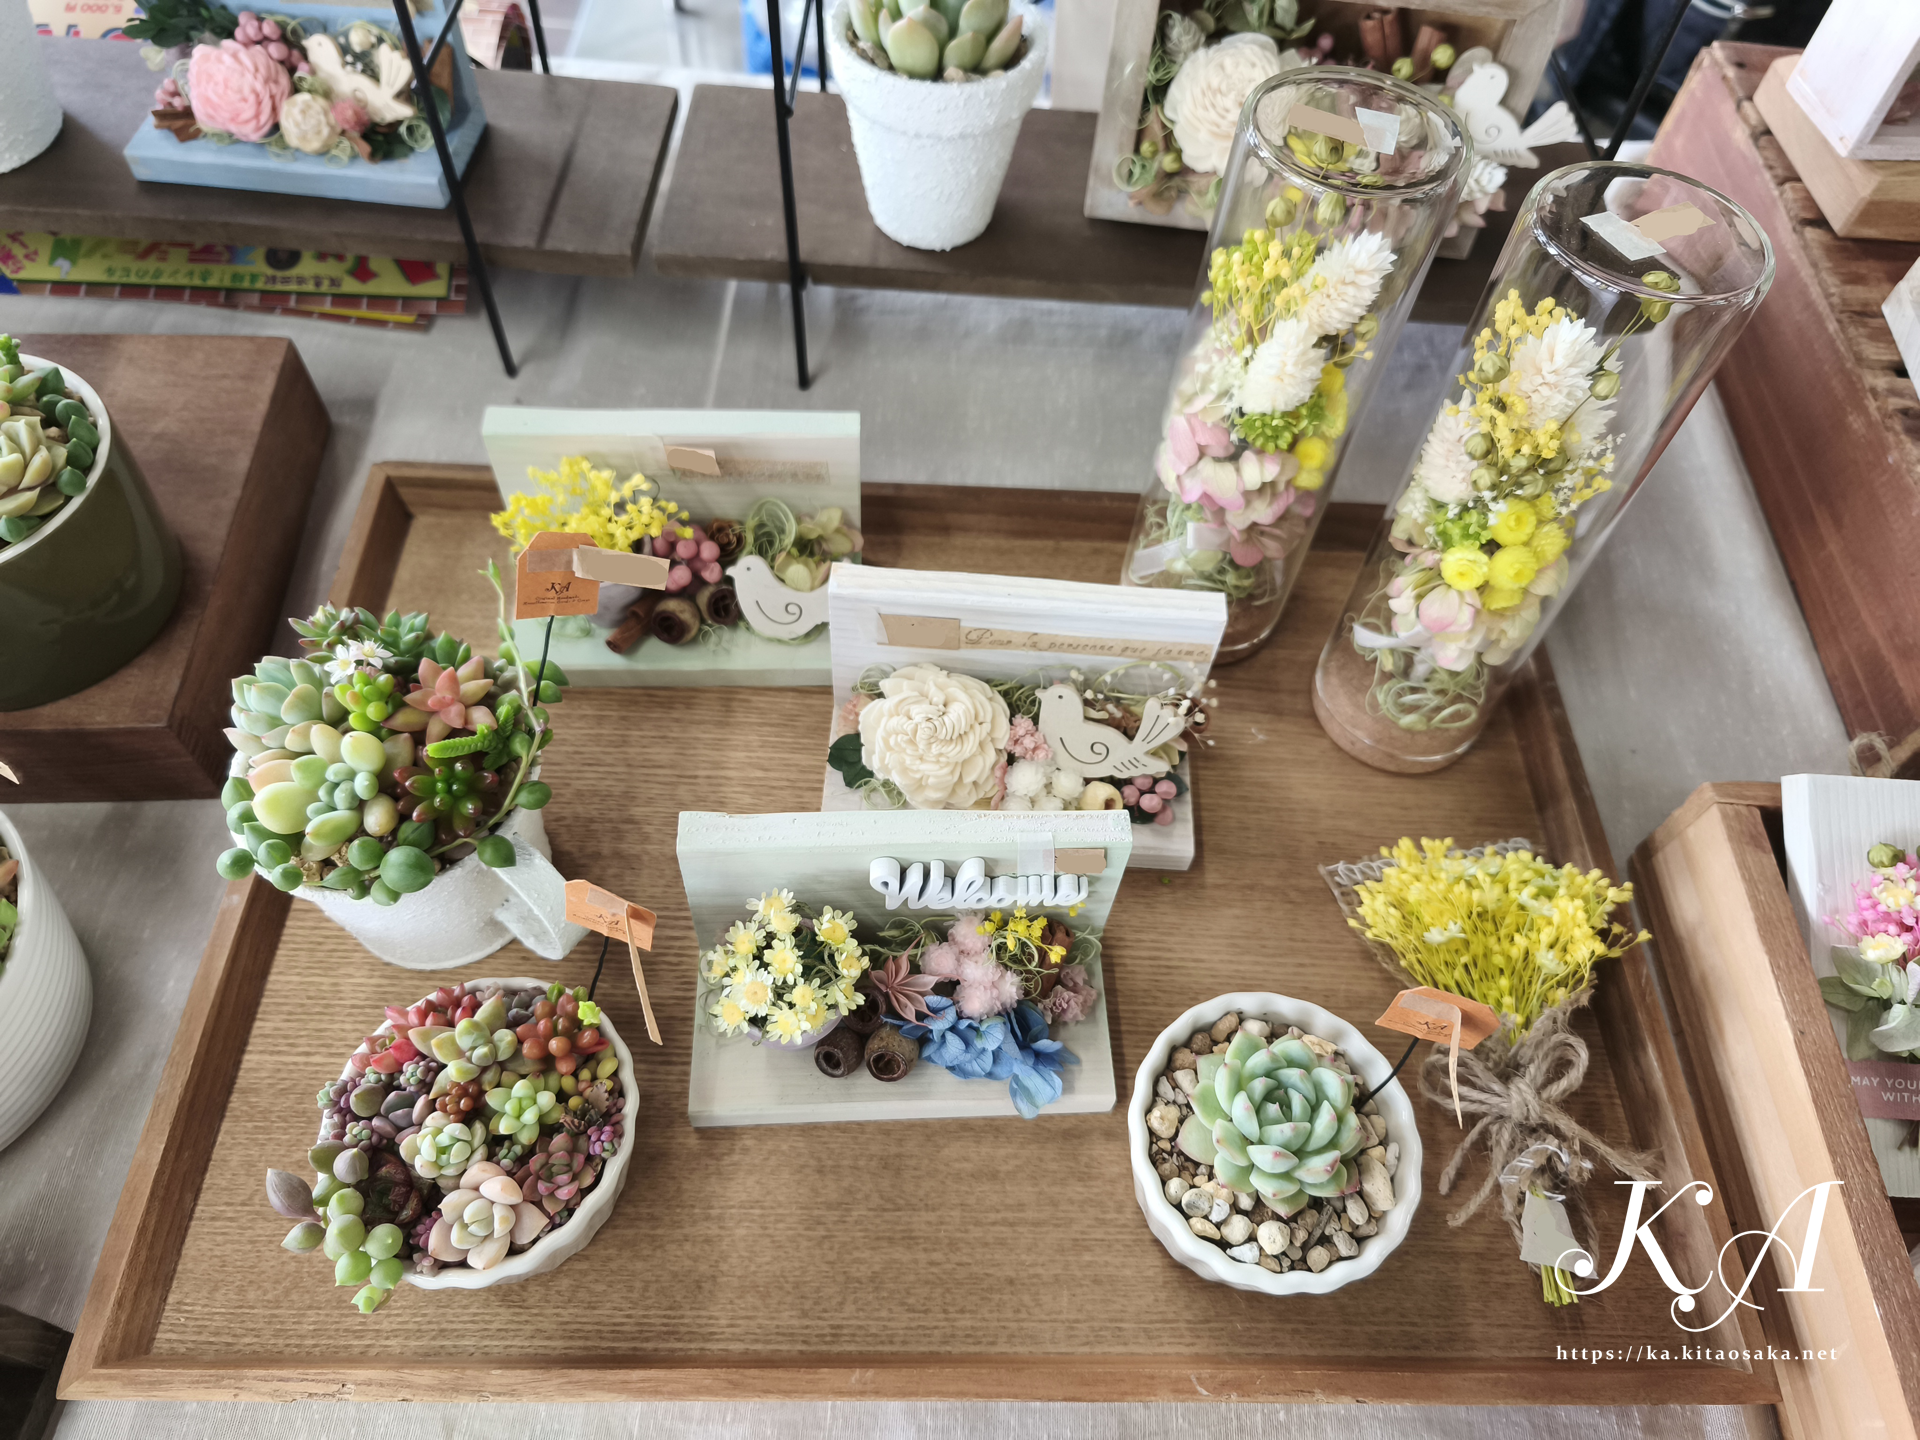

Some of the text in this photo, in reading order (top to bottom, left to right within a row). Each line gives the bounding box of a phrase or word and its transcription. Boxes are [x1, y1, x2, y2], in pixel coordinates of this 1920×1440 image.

[965, 628, 1013, 645] Pour
[869, 856, 1089, 910] Welcome
[1851, 1076, 1920, 1090] MAY YOU
